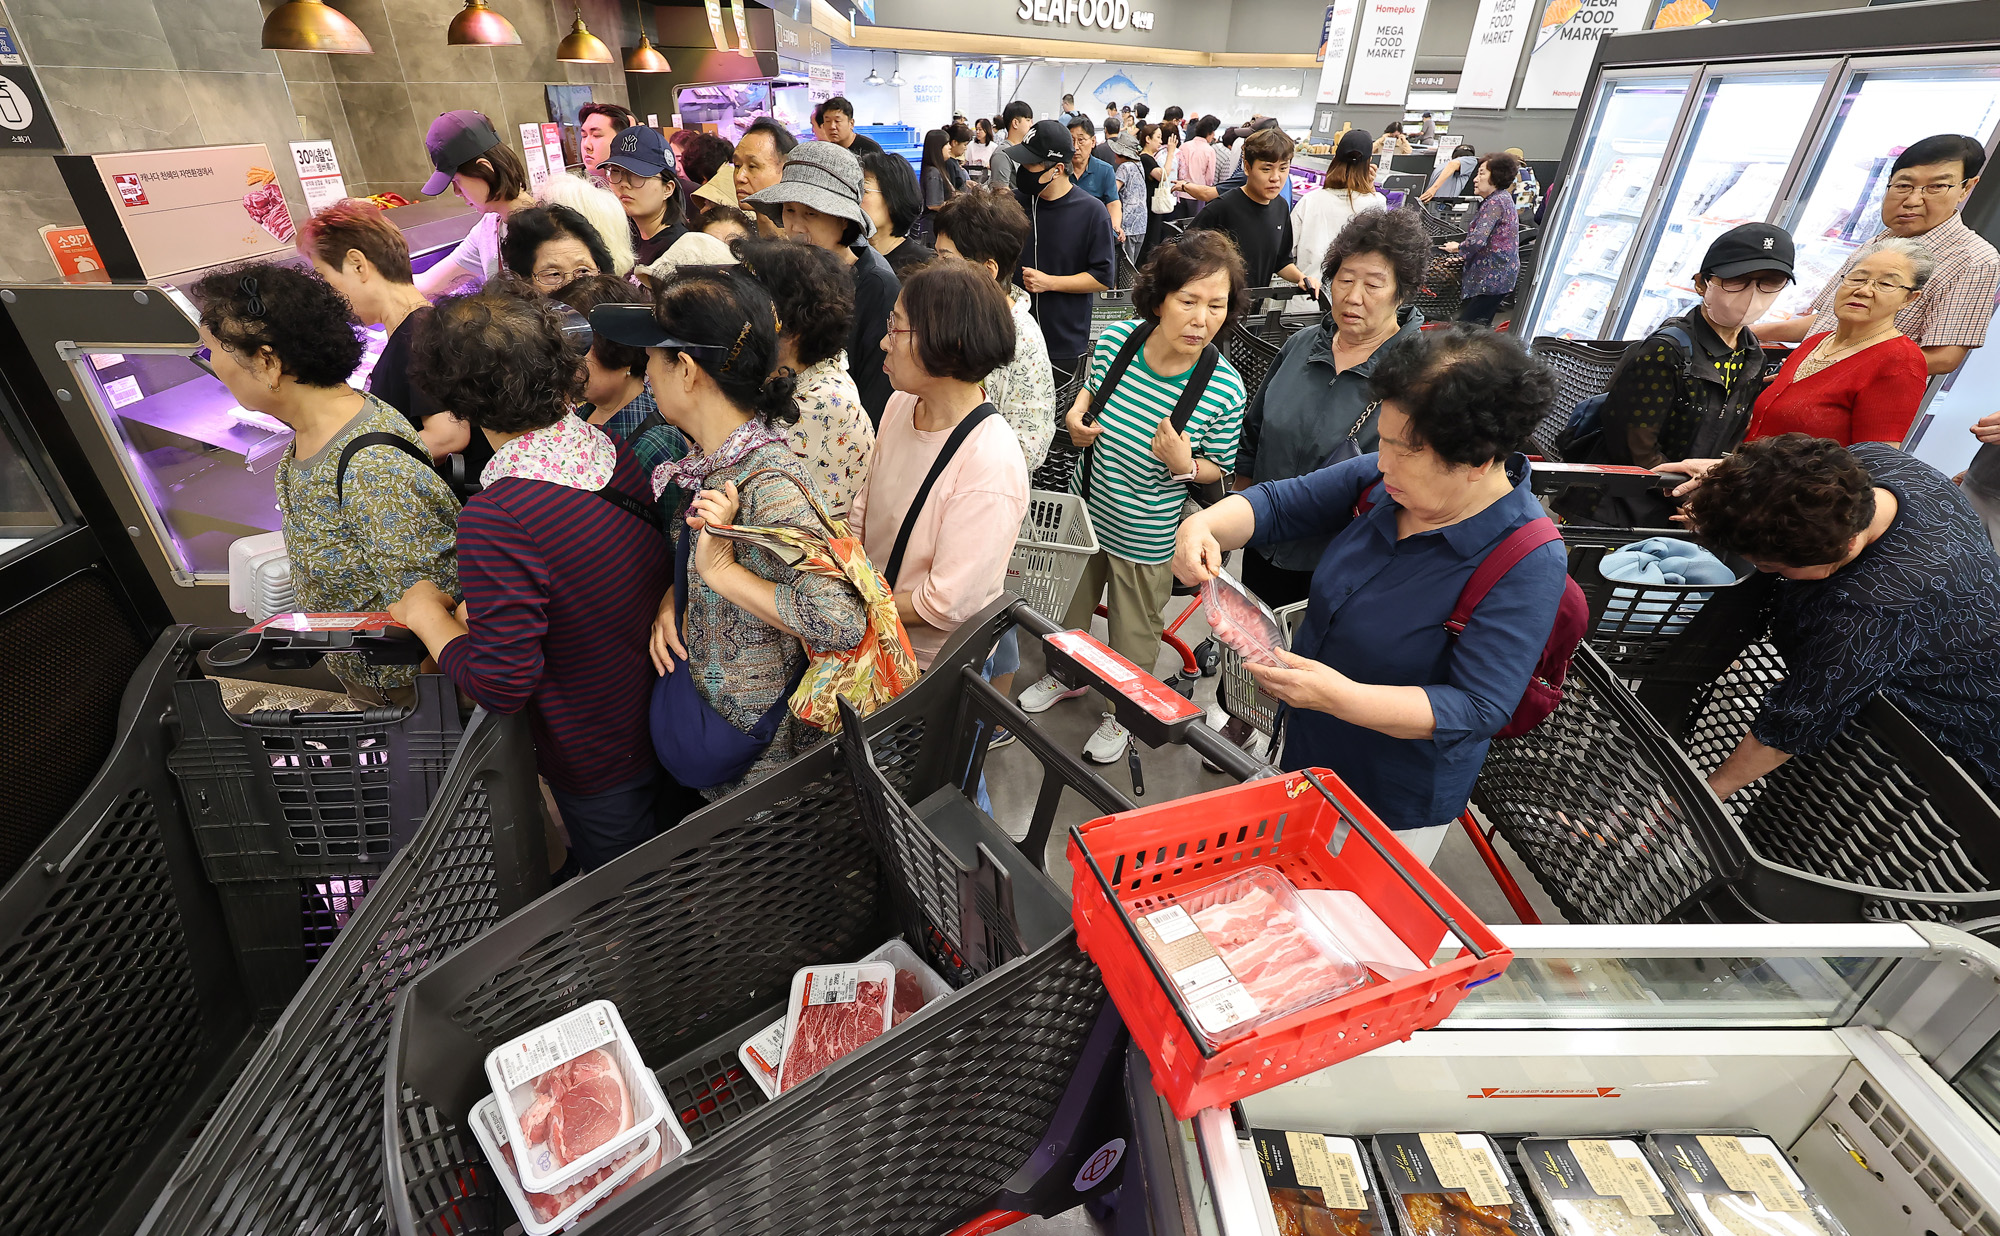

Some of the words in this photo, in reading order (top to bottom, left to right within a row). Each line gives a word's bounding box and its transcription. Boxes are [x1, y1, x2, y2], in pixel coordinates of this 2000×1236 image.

[1017, 0, 1129, 30] SEAFOOD
[1376, 4, 1416, 15] Homeplus
[1573, 10, 1614, 24] FOOD
[1489, 14, 1513, 29] FOOD
[1377, 26, 1404, 35] MEGA
[1481, 30, 1513, 45] MARKET
[1374, 37, 1402, 47] FOOD
[1366, 49, 1405, 58] MARKET
[913, 84, 943, 93] SEAFOOD
[1552, 90, 1581, 98] Homeplus
[915, 95, 940, 103] MARKET
[296, 148, 333, 165] 30%할인
[57, 233, 94, 249] 소화기
[1261, 1139, 1269, 1161] CHOICE
[1396, 1144, 1409, 1166] CHOICE
[1266, 1161, 1274, 1177] CHEF
[1406, 1166, 1416, 1182] CHEF
